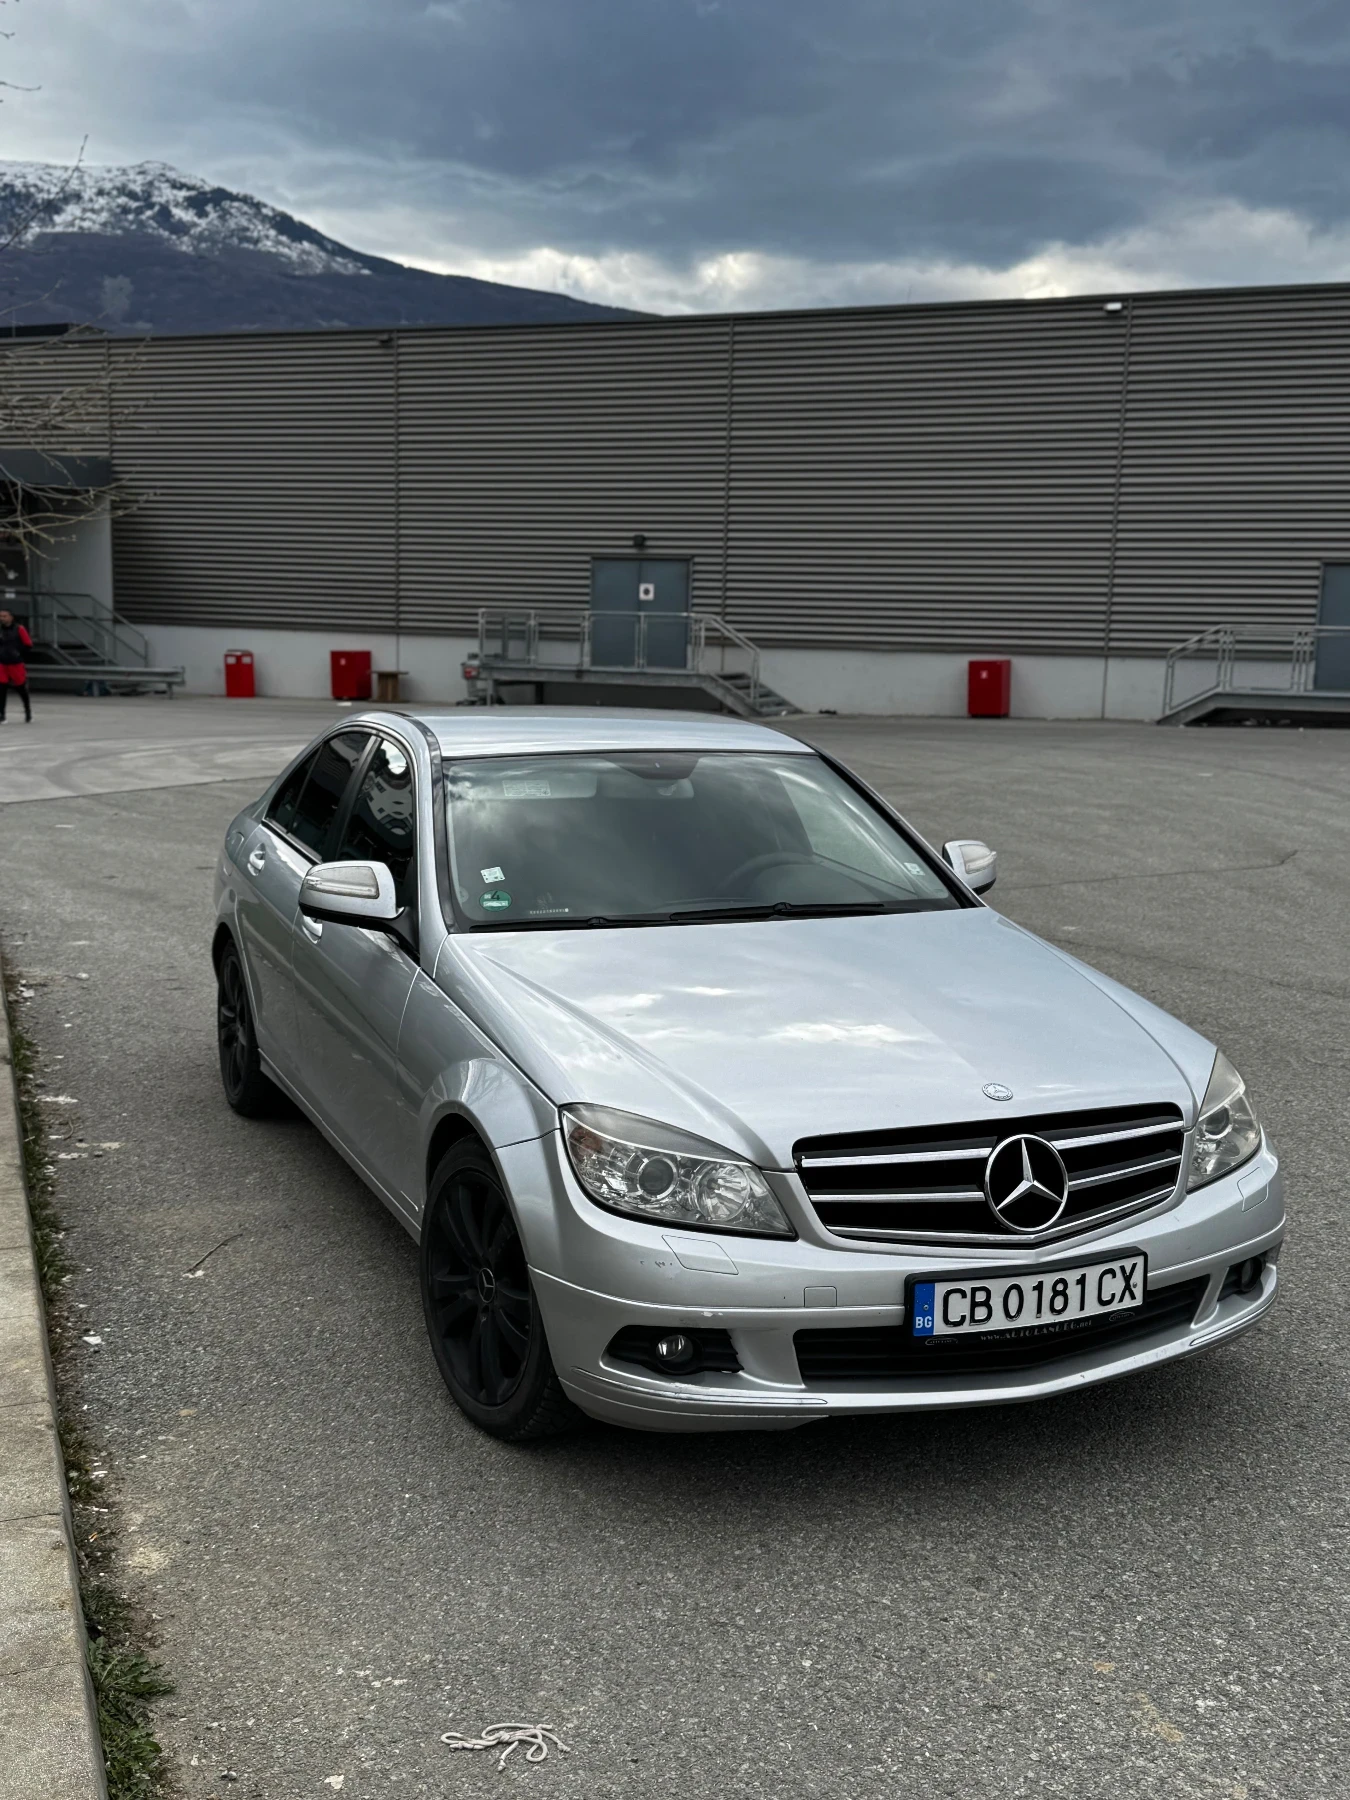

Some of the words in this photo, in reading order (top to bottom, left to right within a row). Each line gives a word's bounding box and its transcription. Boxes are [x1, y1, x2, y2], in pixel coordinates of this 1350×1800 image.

[491, 890, 500, 901] 4
[942, 1285, 993, 1327] CB
[1002, 1272, 1087, 1321] 0181
[1097, 1262, 1138, 1307] CX
[915, 1315, 932, 1328] BG
